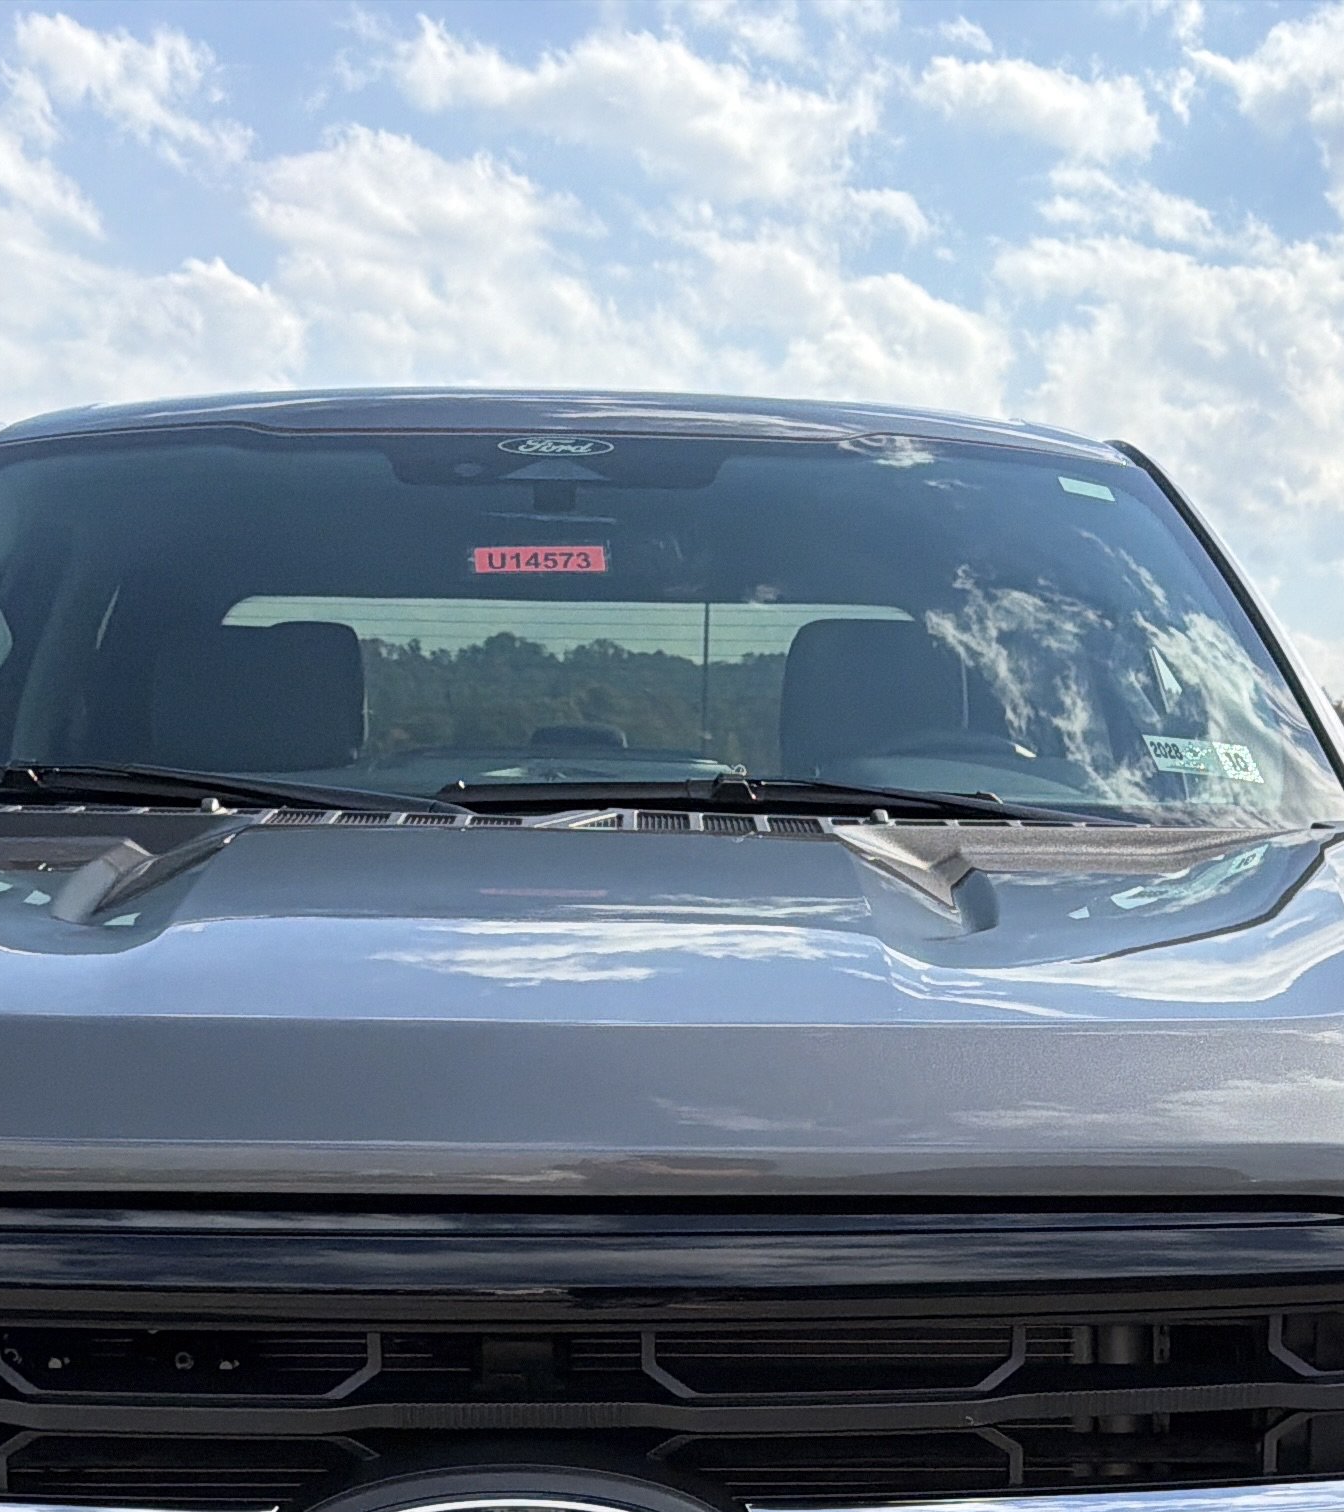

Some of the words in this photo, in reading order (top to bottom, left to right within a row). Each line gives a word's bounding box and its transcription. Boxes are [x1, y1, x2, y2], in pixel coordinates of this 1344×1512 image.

[518, 438, 595, 453] Ford
[487, 551, 592, 570] U14573
[1149, 740, 1184, 761] 2028
